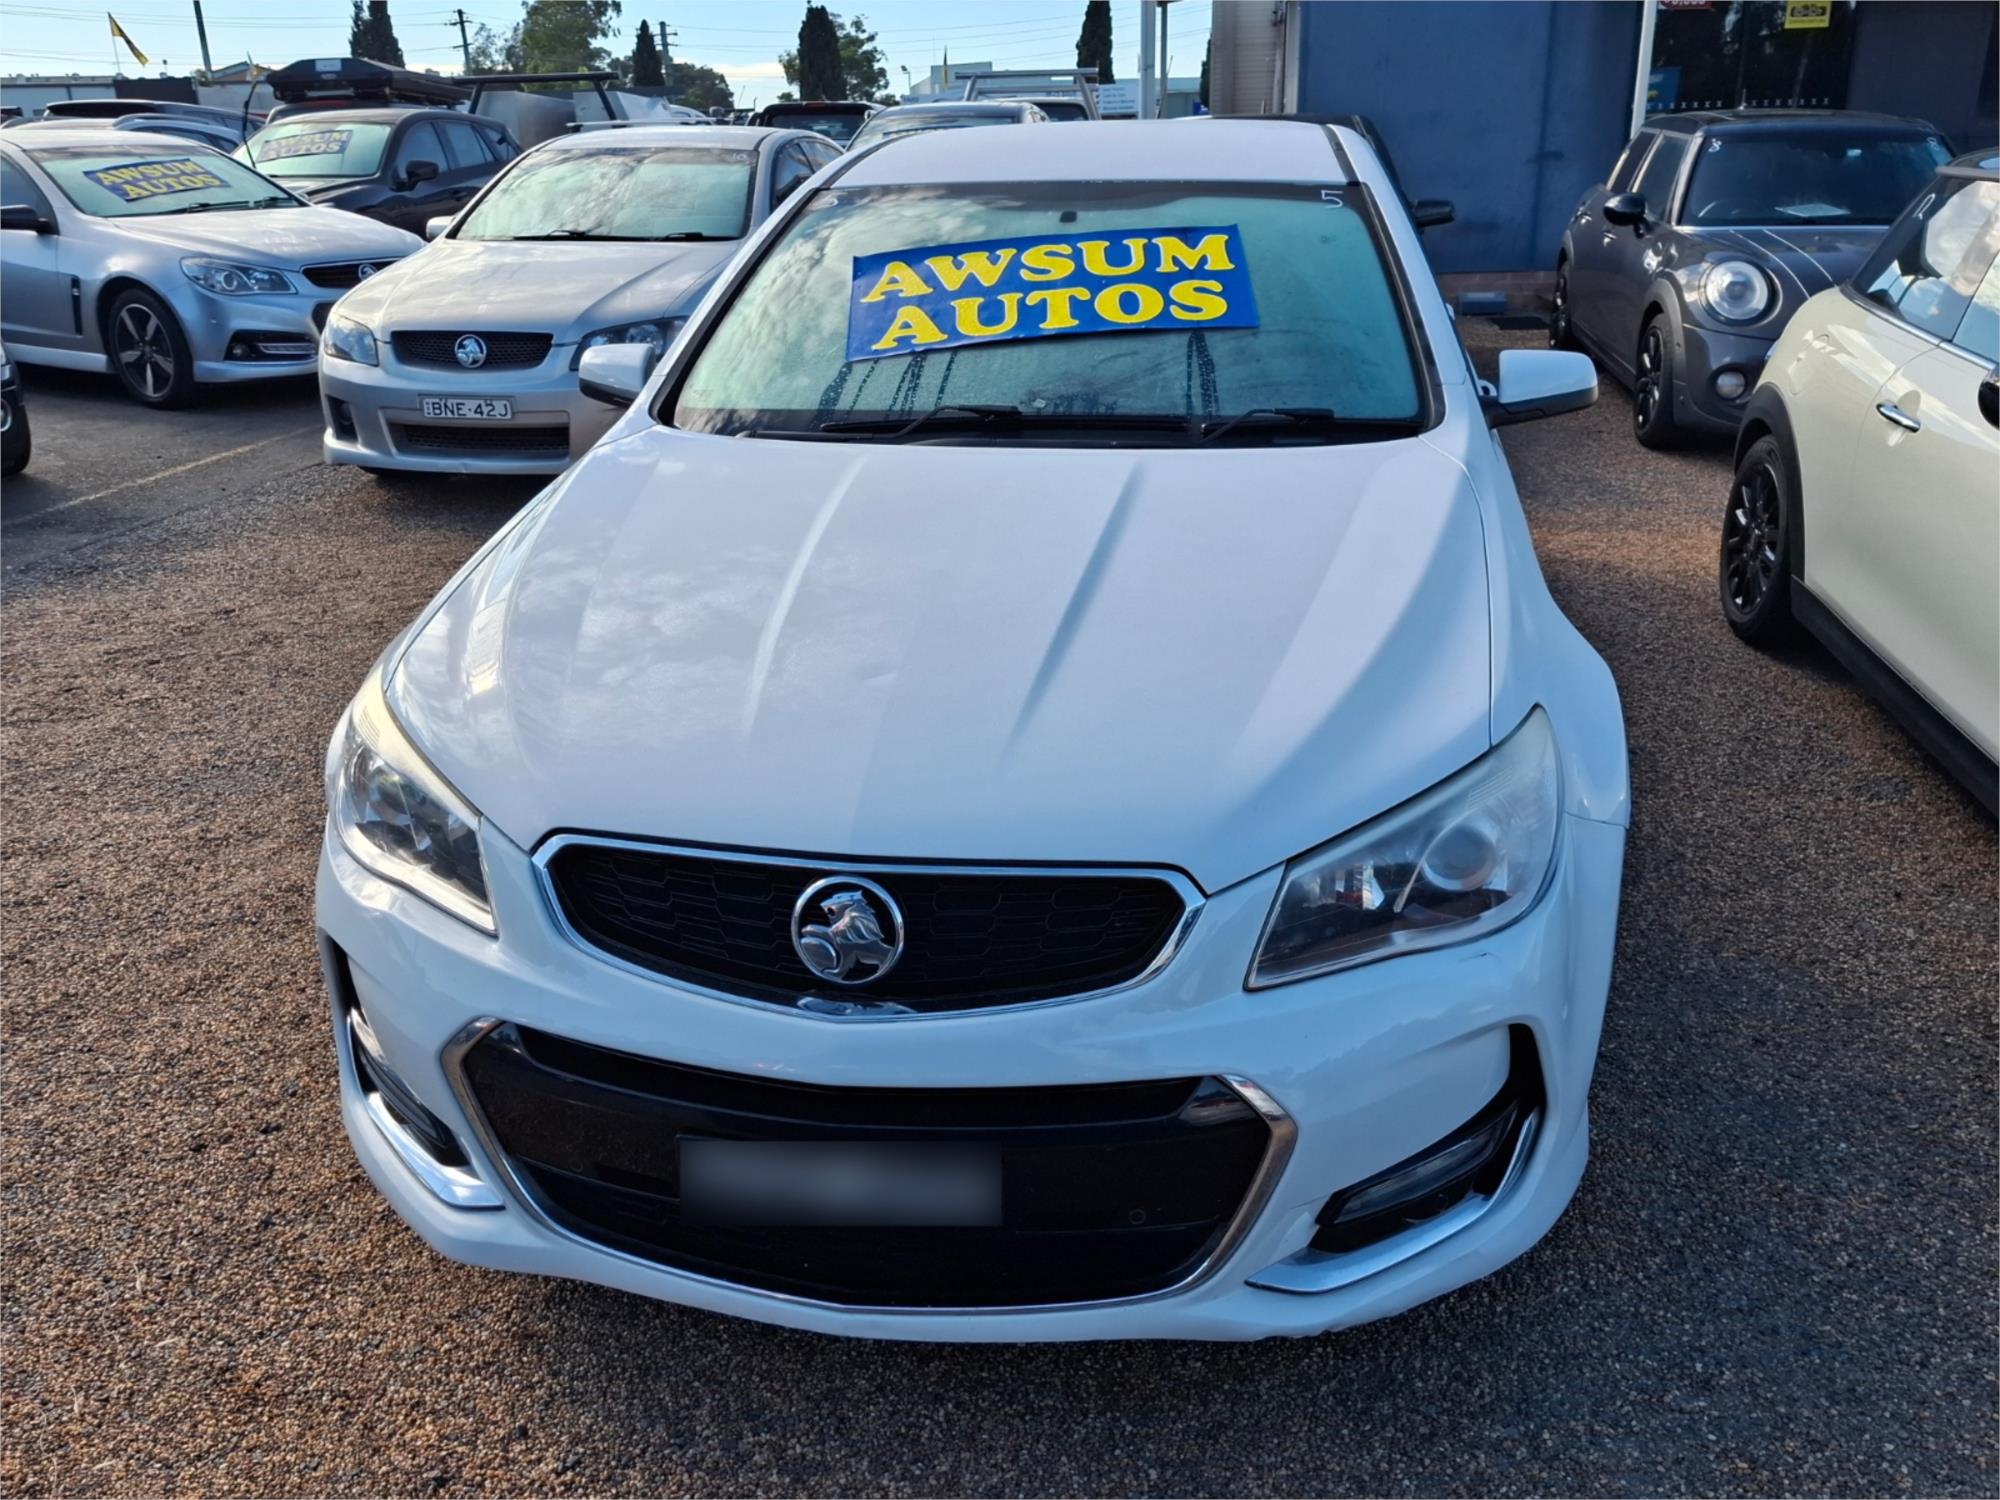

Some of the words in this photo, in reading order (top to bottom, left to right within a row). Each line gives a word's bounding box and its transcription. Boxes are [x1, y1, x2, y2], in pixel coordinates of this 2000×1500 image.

[95, 160, 205, 186] AWSUM
[122, 174, 222, 199] AUTOS
[1320, 190, 1344, 208] 5
[860, 234, 1235, 302] AWSUM
[871, 279, 1228, 350] AUTOS
